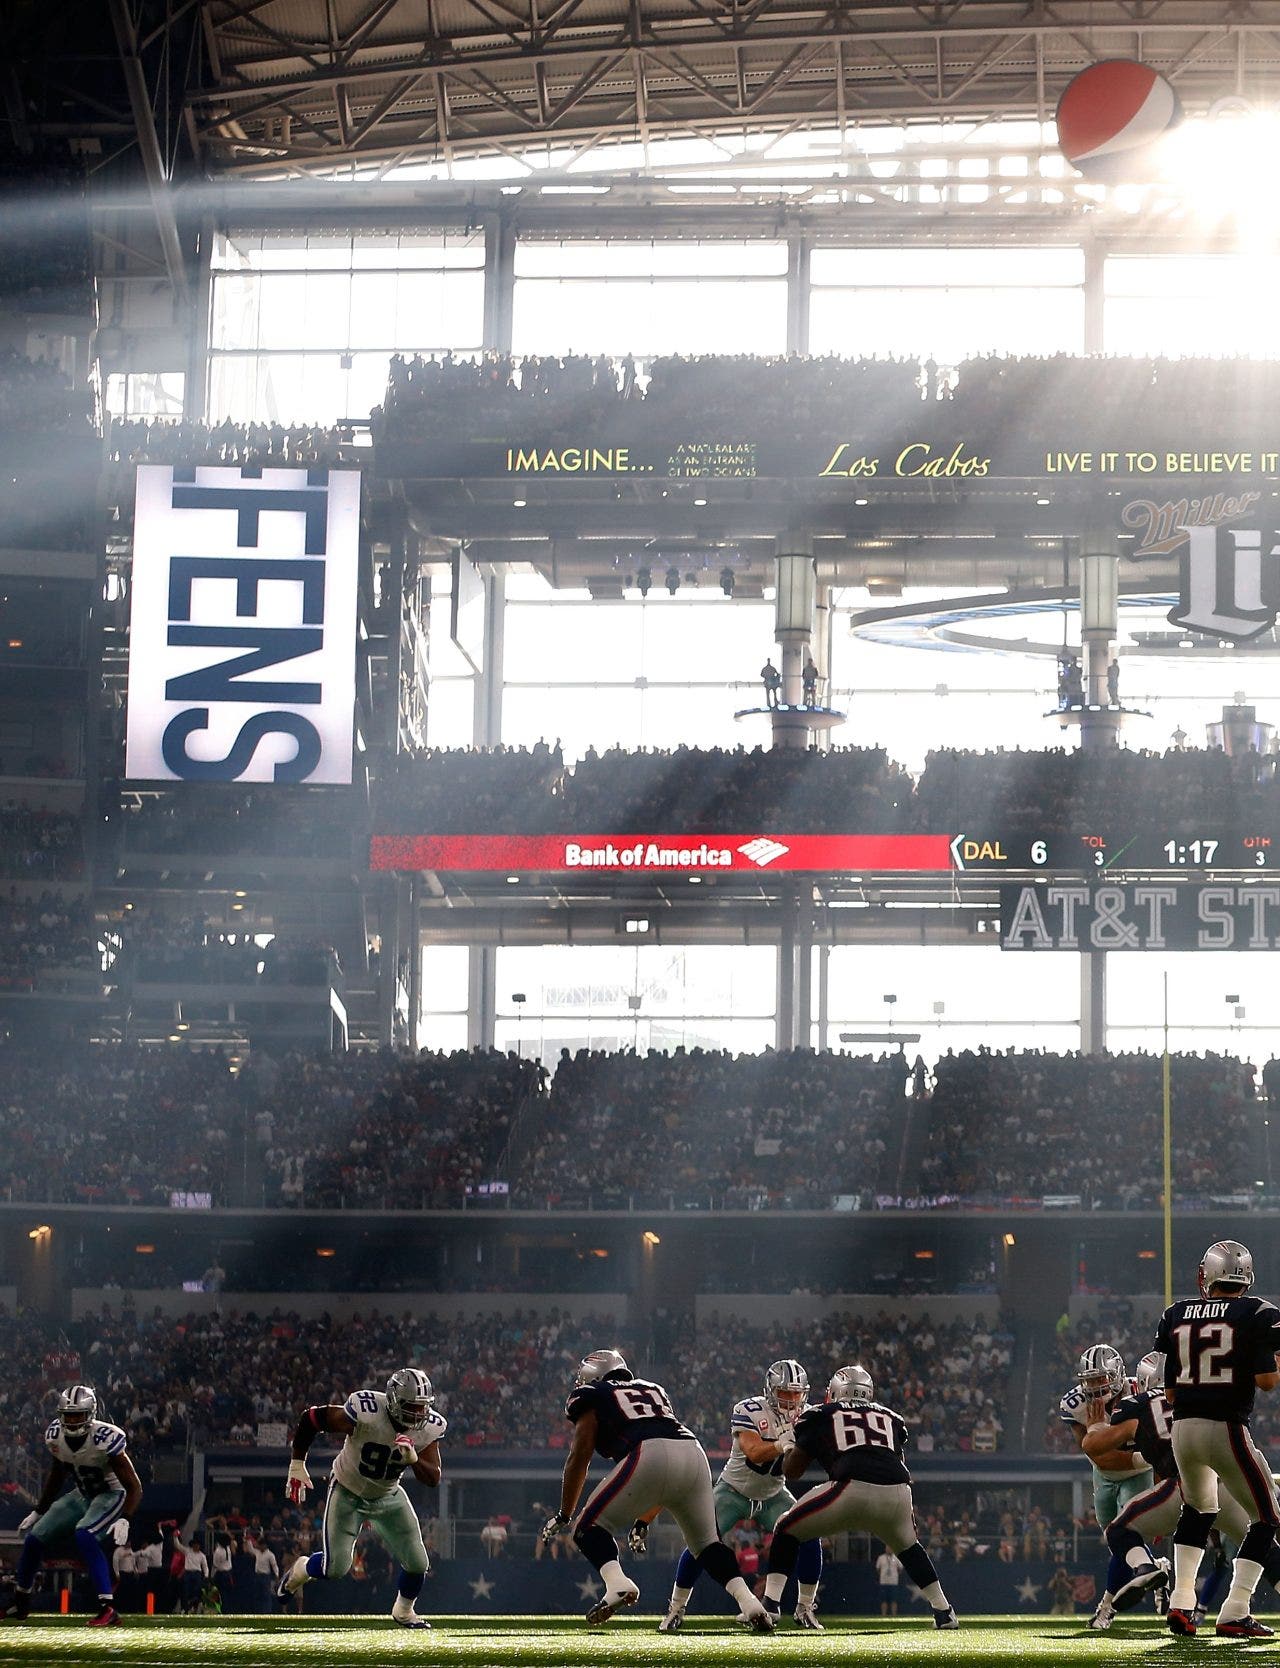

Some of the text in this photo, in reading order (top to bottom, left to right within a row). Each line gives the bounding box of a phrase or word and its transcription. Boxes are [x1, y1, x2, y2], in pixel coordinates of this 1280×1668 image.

[505, 448, 654, 472] IMAGINE...
[818, 442, 991, 478] Los Cabos
[1046, 452, 1279, 473] LIVE IT TO BELIEVE IT
[1121, 491, 1262, 556] Miller
[565, 843, 732, 866] Bank of America
[963, 841, 1008, 861] DAL
[1030, 840, 1048, 864] 6
[1094, 851, 1105, 866] 3
[1163, 840, 1219, 864] 1:17
[1255, 851, 1266, 866] 3
[1003, 887, 1178, 948] AT&T
[1182, 1302, 1231, 1320] BRADY
[1173, 1322, 1234, 1385] 12
[613, 1388, 675, 1420] 61
[94, 1426, 114, 1446] 42
[831, 1410, 895, 1452] 69
